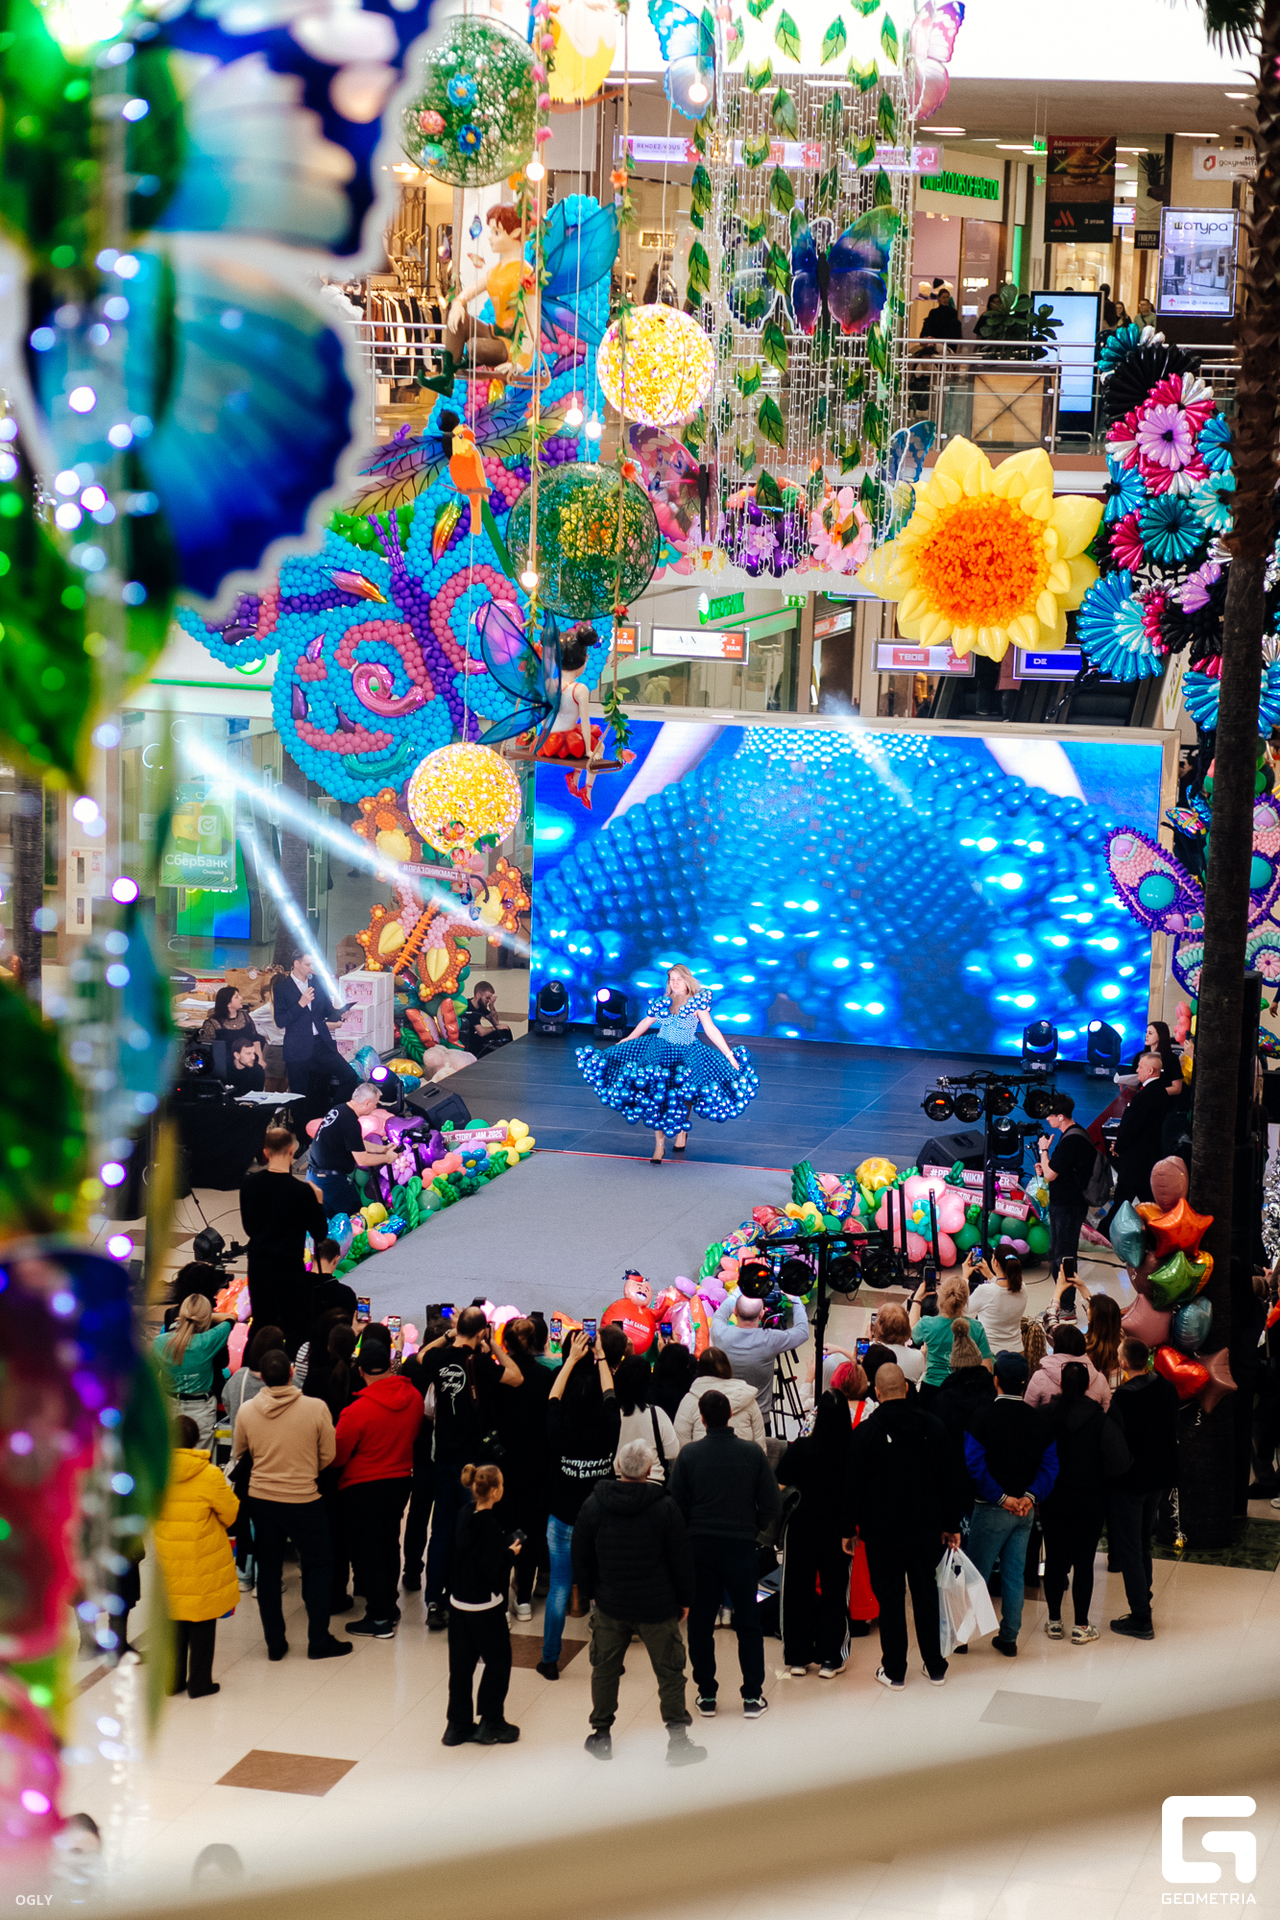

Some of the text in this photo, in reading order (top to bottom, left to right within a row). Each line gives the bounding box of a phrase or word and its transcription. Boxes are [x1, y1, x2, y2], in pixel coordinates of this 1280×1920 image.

[898, 653, 925, 661] ТВОЕ
[164, 854, 228, 869] СберБанк
[402, 864, 467, 880] #ПРАЗДНИКМАСТР
